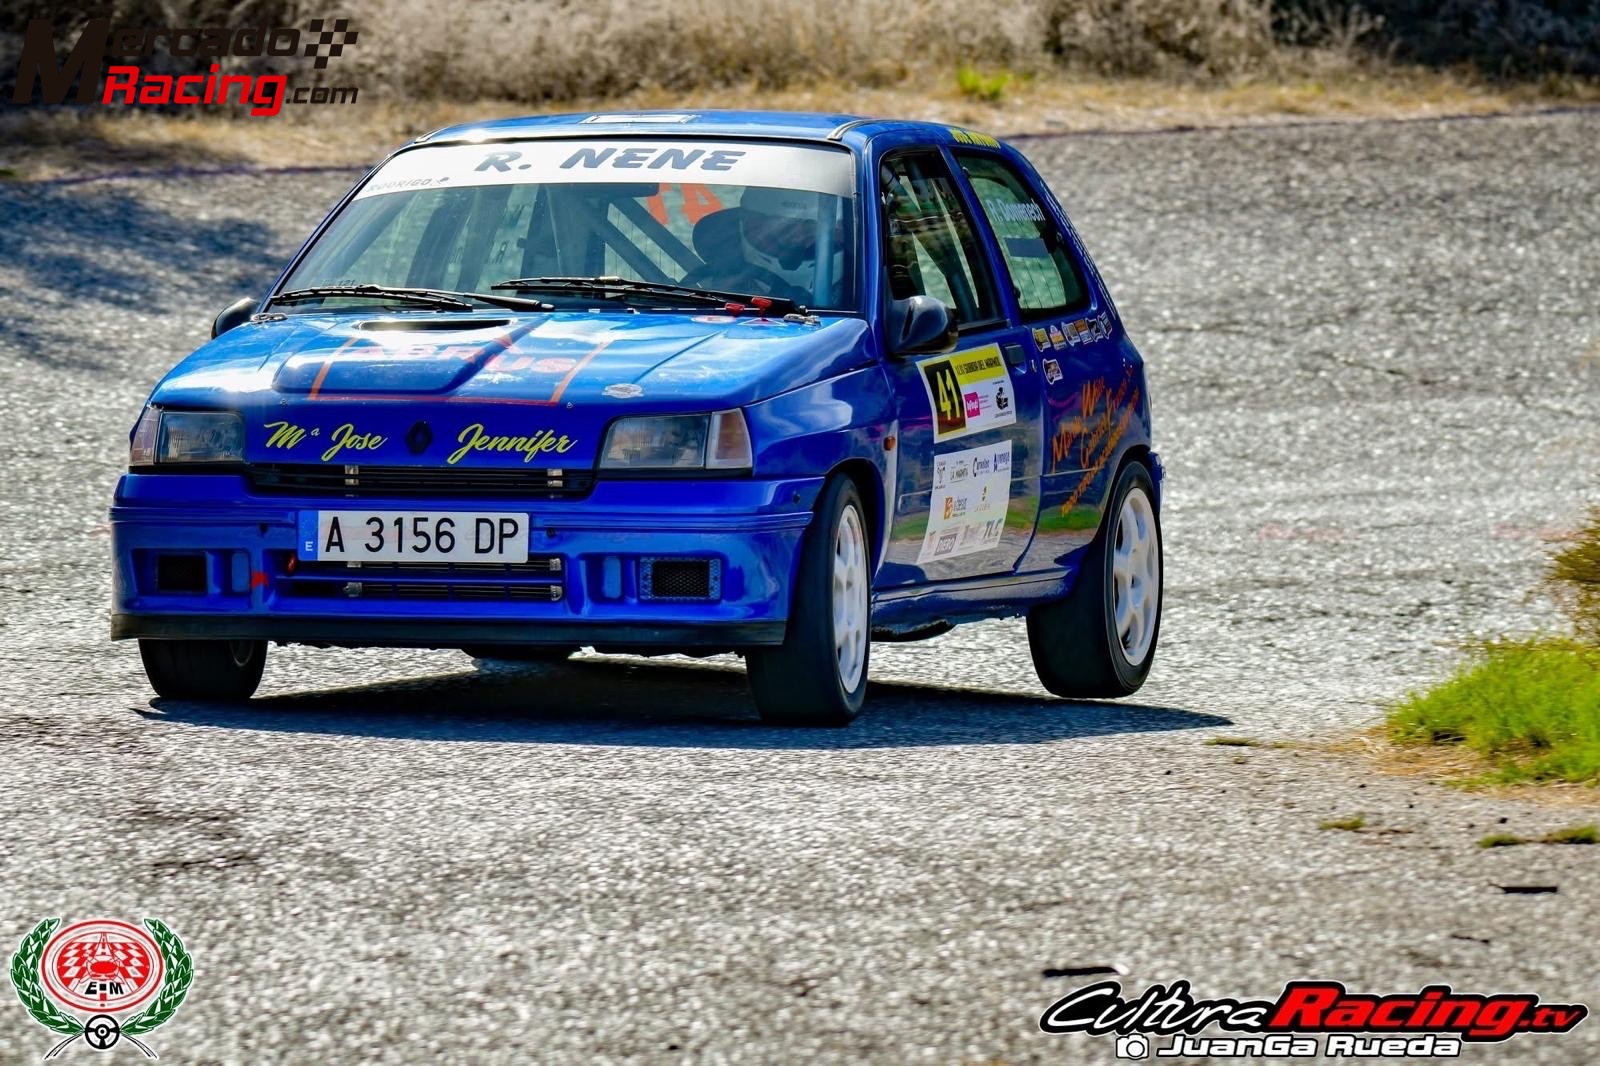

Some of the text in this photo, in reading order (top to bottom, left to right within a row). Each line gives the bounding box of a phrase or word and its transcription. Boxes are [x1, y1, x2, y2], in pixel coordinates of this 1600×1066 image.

[474, 147, 747, 172] R. NENE
[936, 368, 961, 421] 41
[321, 423, 388, 462] Jose
[447, 423, 578, 465] Jennifer
[304, 540, 314, 552] E
[324, 516, 519, 555] A 3156 DP
